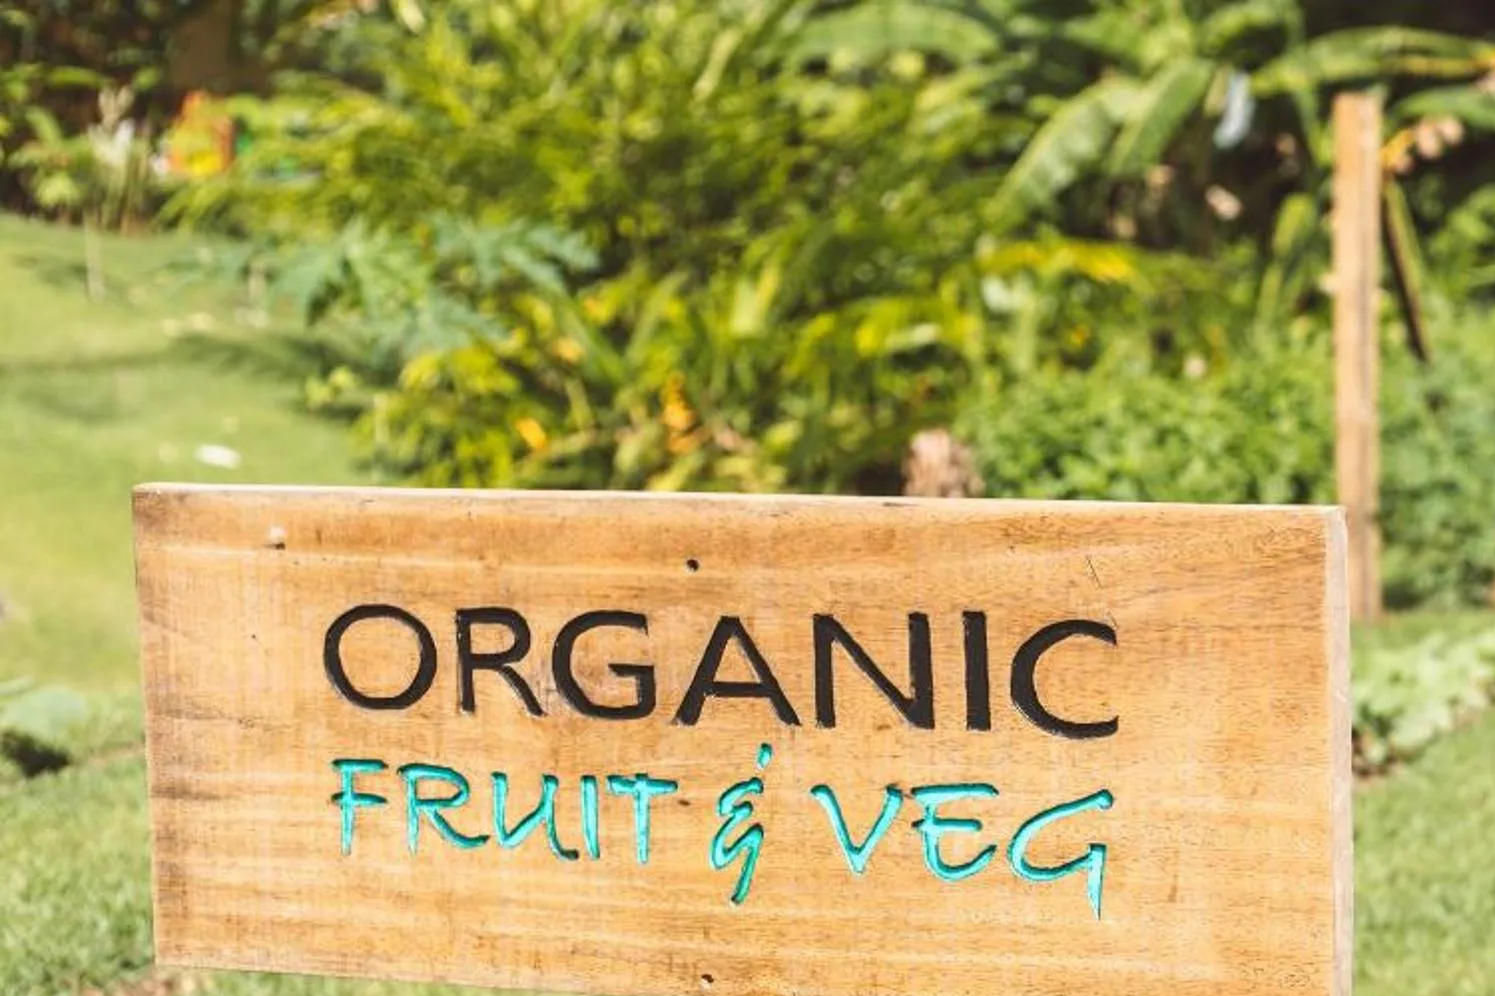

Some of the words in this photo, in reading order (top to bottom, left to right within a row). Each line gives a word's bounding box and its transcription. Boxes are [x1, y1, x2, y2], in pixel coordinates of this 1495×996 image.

[323, 603, 1118, 740] ORGANIC
[331, 757, 679, 864] FRUIT
[707, 742, 774, 905] &
[809, 782, 1116, 920] VEG
